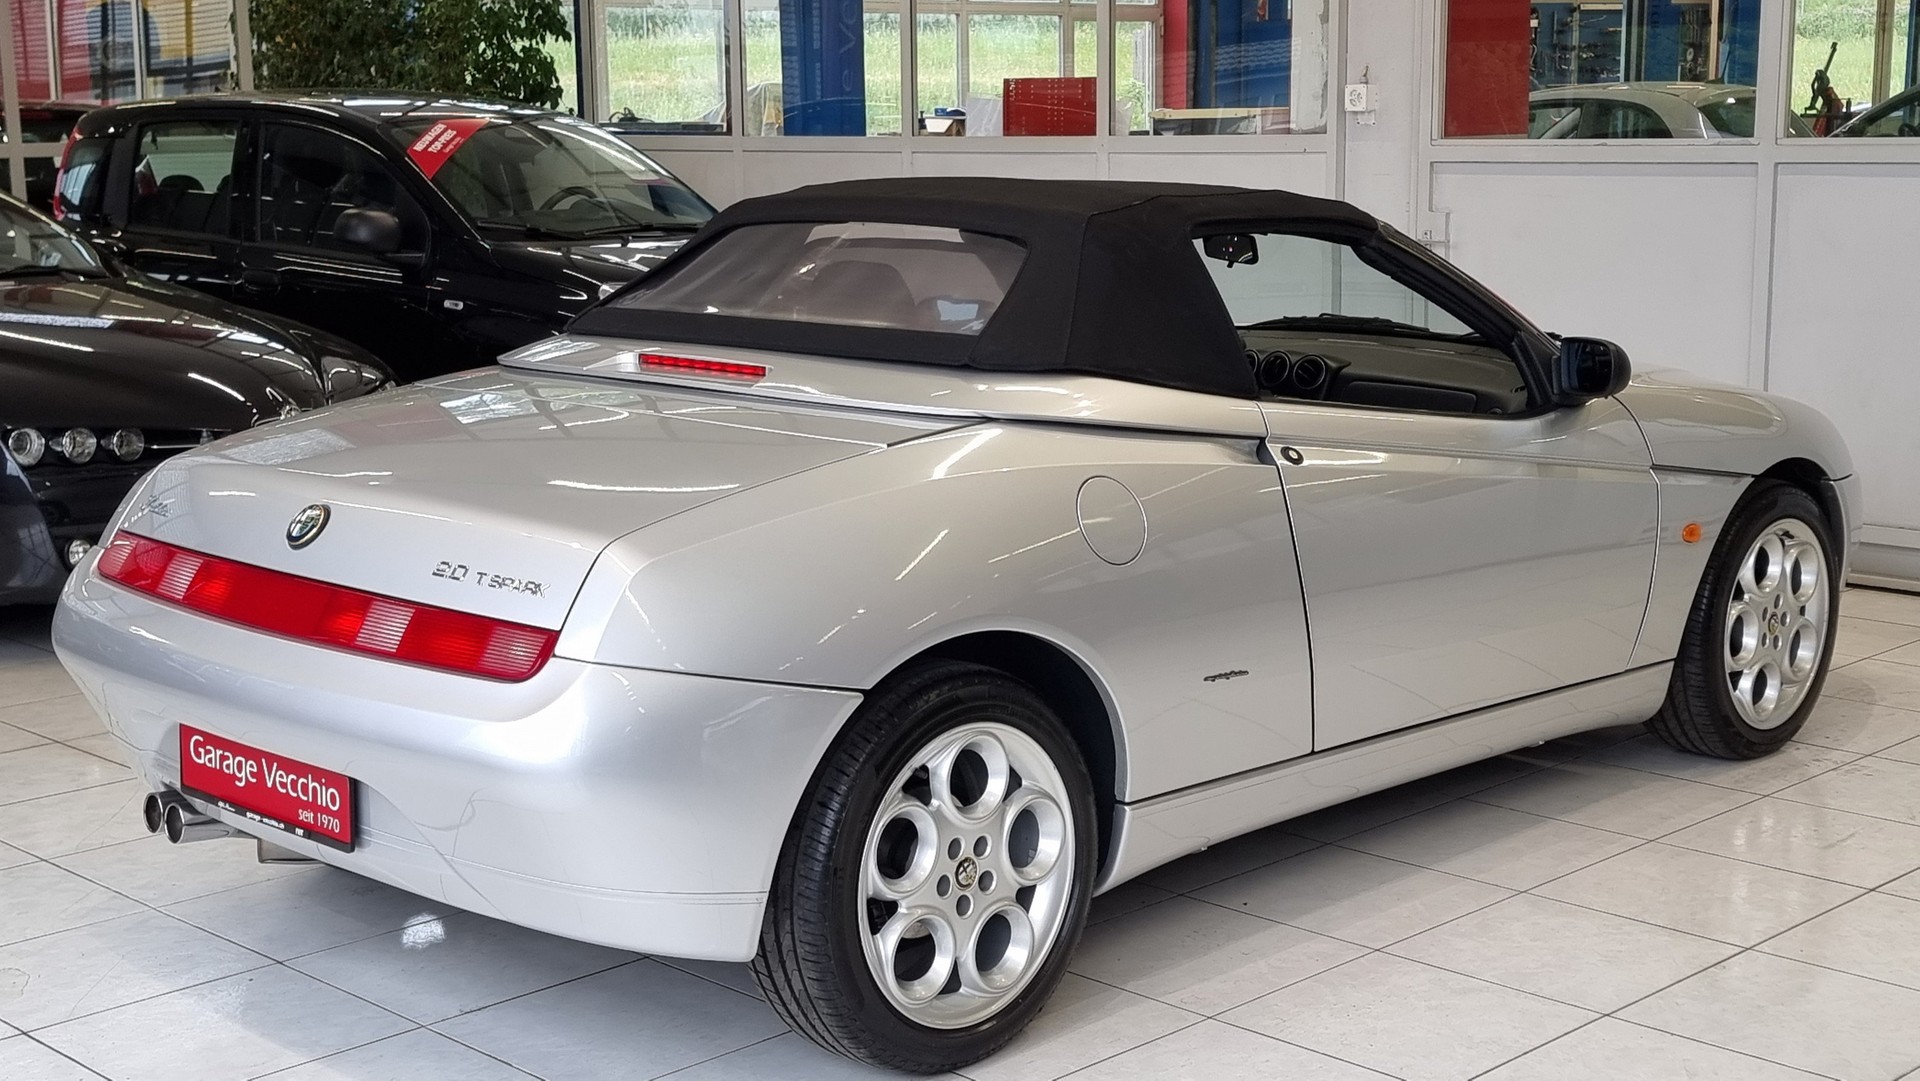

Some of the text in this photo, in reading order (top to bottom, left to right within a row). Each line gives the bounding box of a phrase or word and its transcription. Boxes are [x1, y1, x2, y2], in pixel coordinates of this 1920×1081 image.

[487, 574, 550, 599] SPARK
[189, 735, 341, 811] Garage Vecchio
[298, 809, 314, 825] seit
[317, 812, 341, 834] 1970
